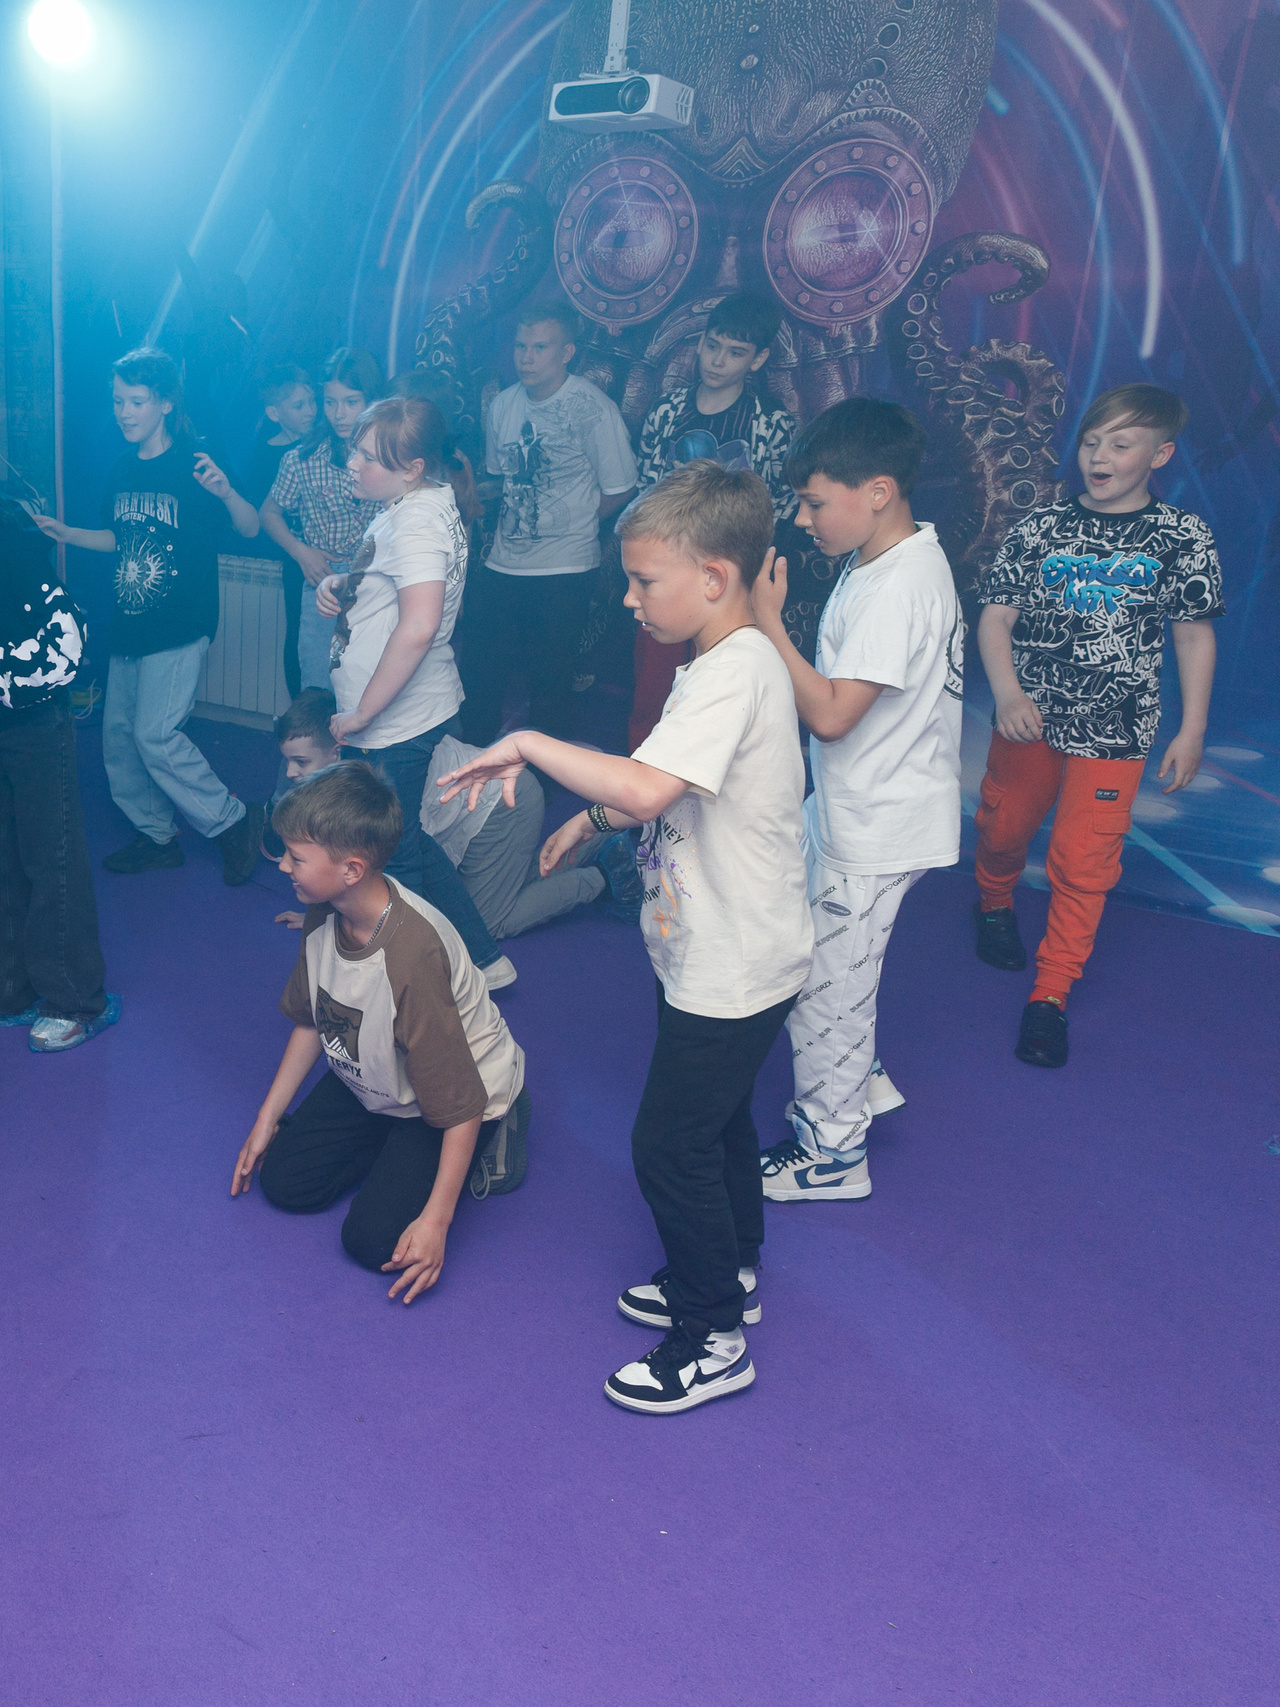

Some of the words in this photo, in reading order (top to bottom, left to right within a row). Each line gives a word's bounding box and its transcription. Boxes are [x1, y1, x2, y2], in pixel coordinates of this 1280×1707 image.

[140, 492, 156, 517] THE
[157, 493, 179, 529] SKY
[1040, 551, 1163, 590] STREET
[994, 595, 1010, 605] OF
[1062, 581, 1127, 618] ART
[329, 1055, 363, 1079] TERYX
